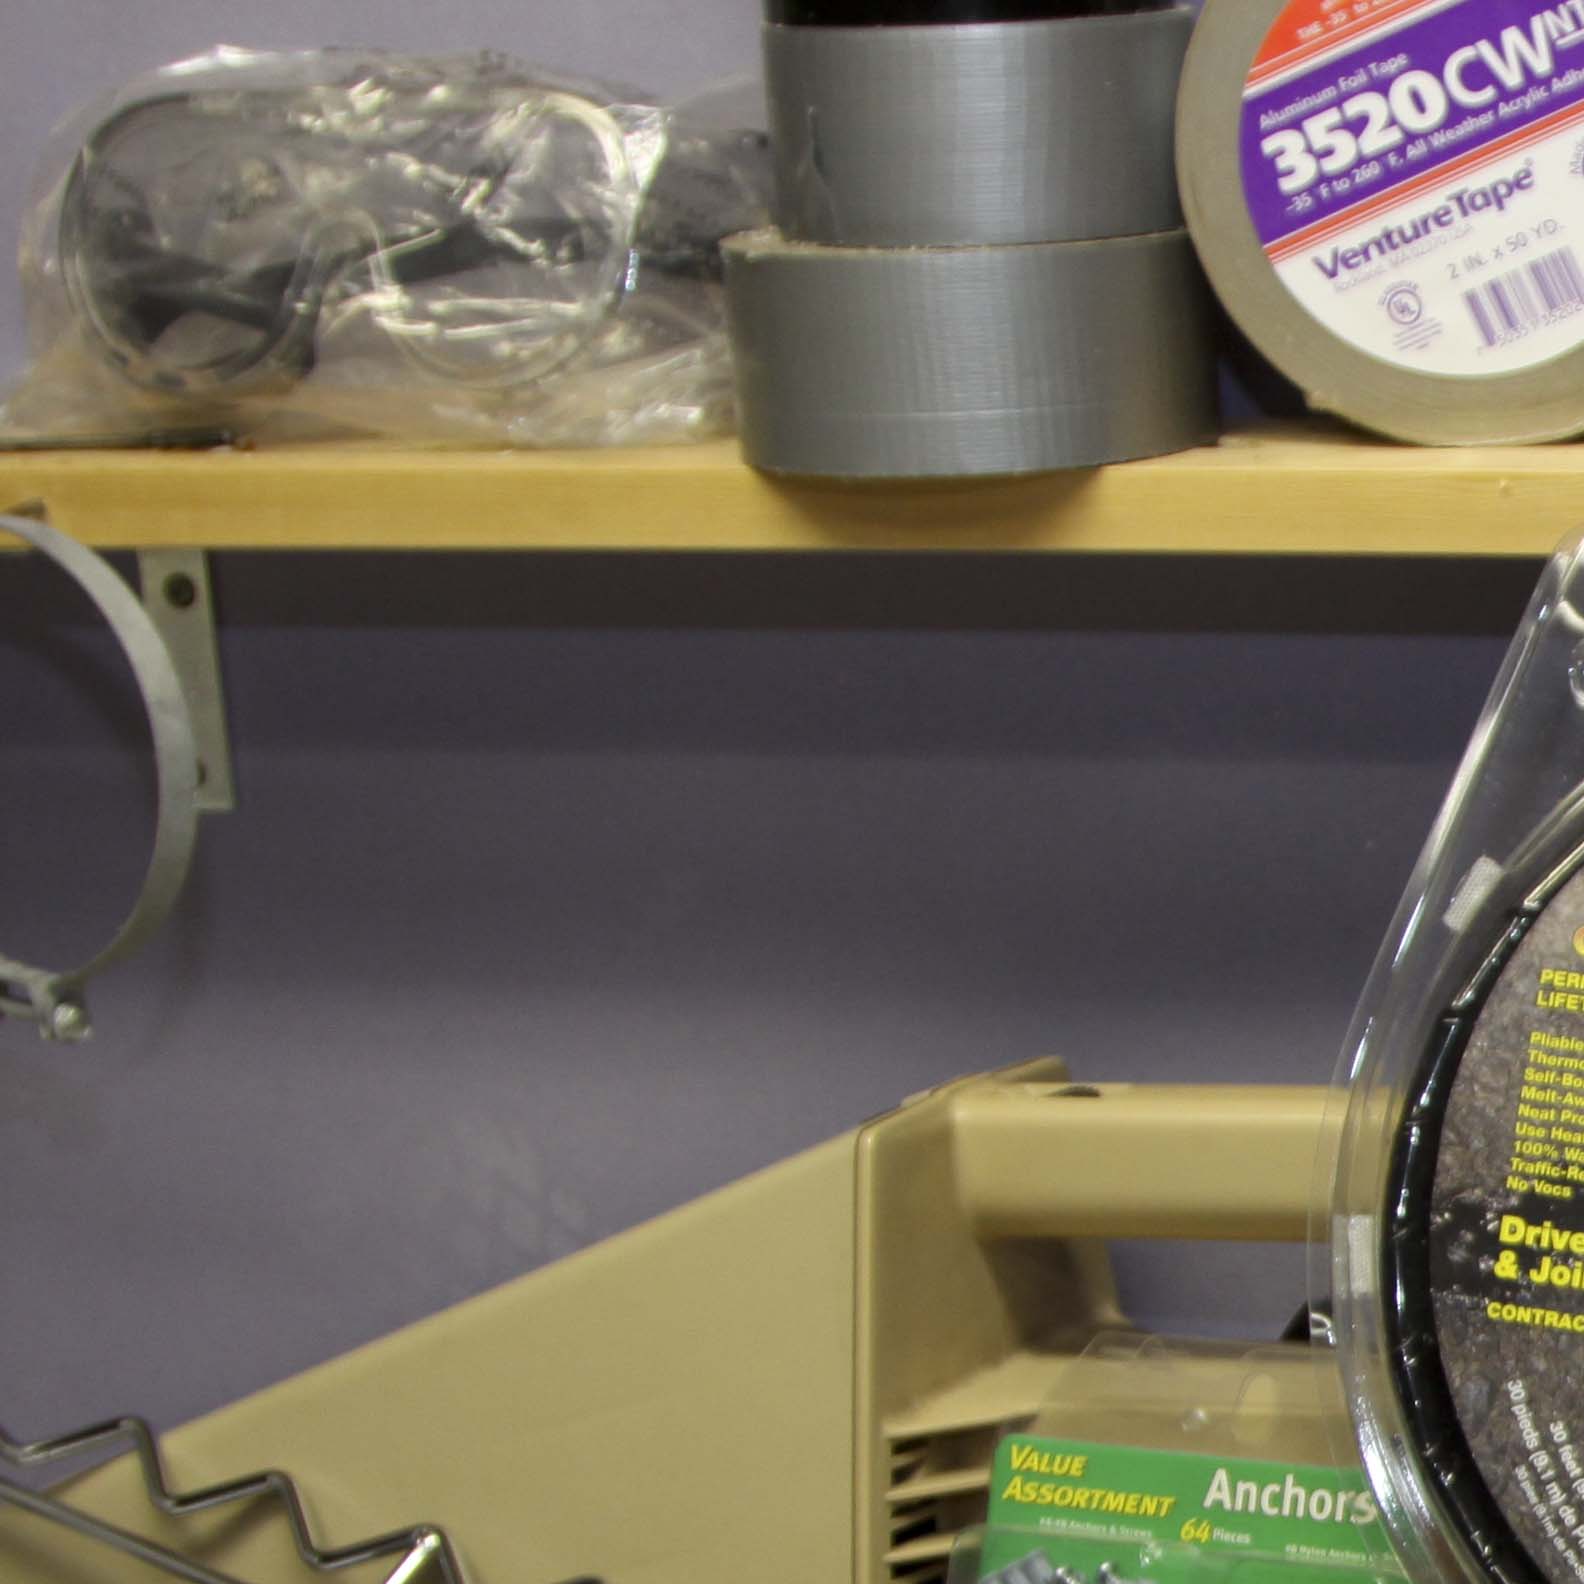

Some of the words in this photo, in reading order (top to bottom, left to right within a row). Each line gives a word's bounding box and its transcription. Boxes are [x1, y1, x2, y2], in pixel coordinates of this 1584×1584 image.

[1258, 84, 1339, 131] Aluminum
[1338, 66, 1370, 92] Foil
[1369, 52, 1410, 81] Tape
[1428, 109, 1496, 150] Weather
[1498, 86, 1550, 121] Acrylic
[1505, 235, 1530, 255] 50
[1518, 1103, 1557, 1121] Neat
[1506, 1175, 1529, 1192] No
[1494, 1250, 1519, 1281] &
[1203, 1468, 1379, 1525] Anchors
[1180, 1518, 1212, 1544] 64
[1213, 1527, 1252, 1545] Pieces
